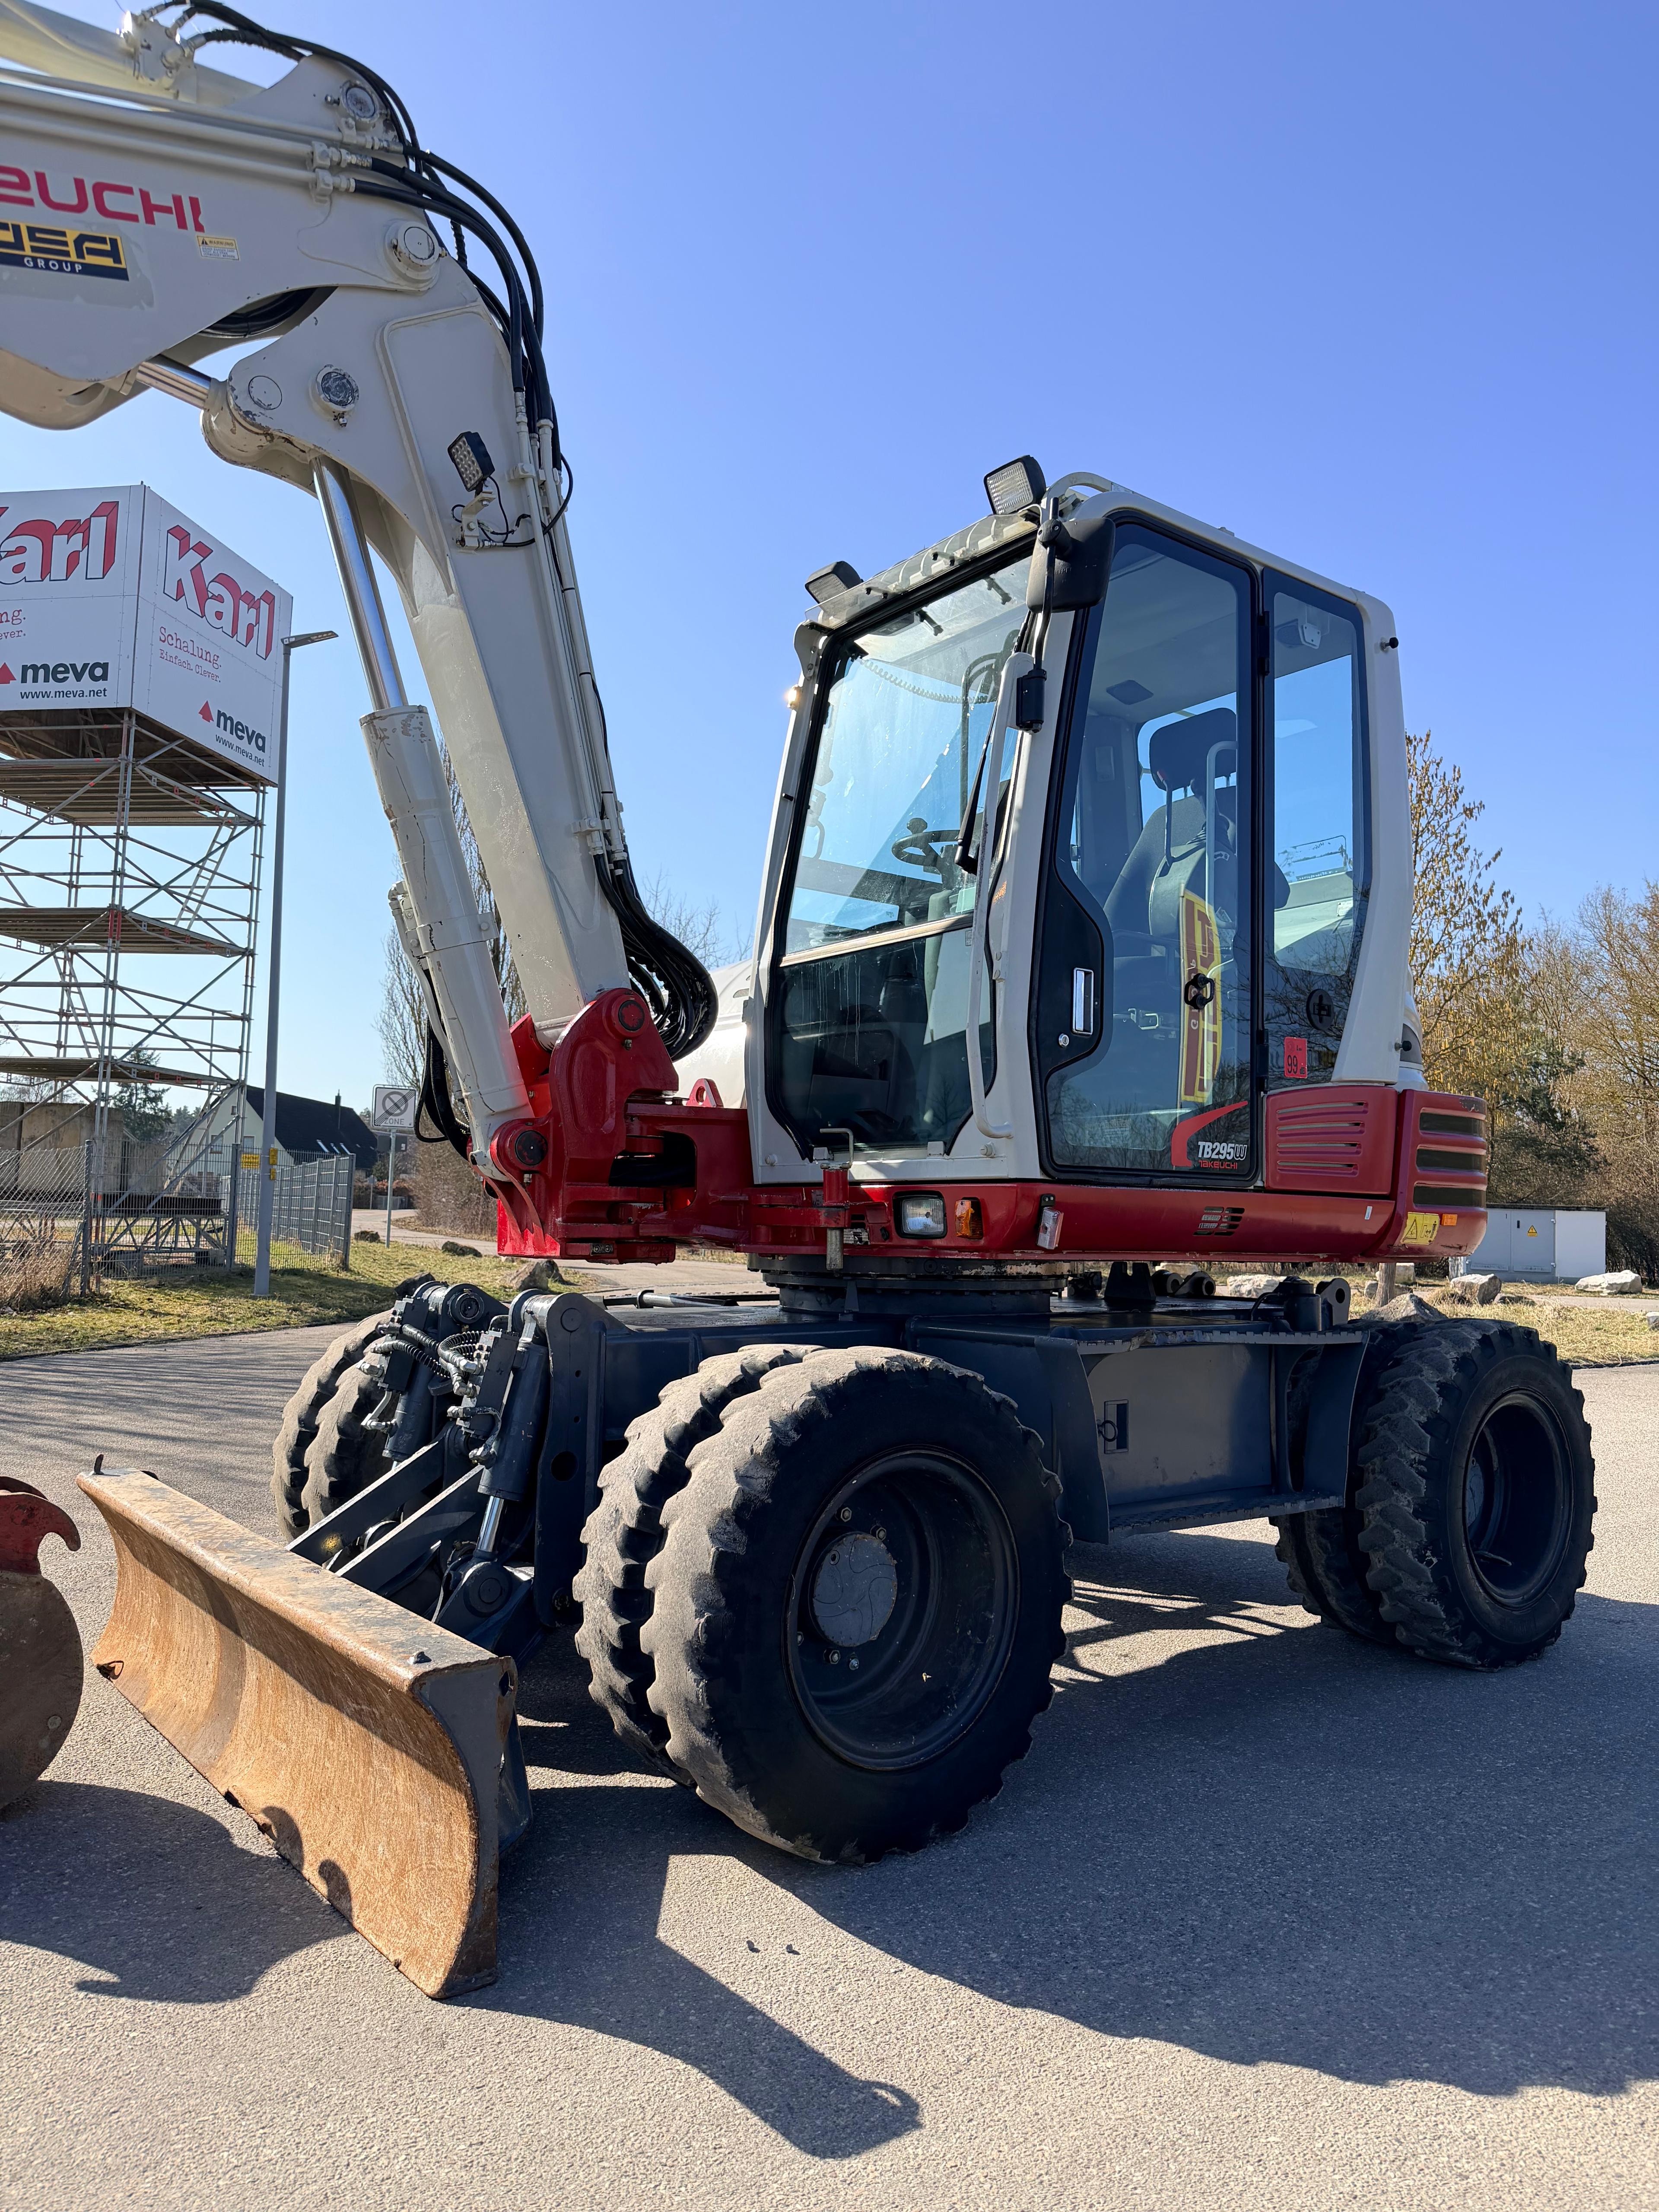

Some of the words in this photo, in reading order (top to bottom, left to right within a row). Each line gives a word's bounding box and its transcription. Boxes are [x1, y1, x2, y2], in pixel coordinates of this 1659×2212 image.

[24, 257, 82, 273] GROUP
[0, 501, 119, 585] arl
[163, 524, 275, 661] Karl
[159, 626, 221, 669] Schalung.
[21, 662, 109, 683] meva
[159, 649, 193, 671] Einfach.
[195, 664, 221, 683] Clever.
[20, 688, 107, 699] www.meva.net
[216, 709, 266, 753] meva
[216, 734, 264, 767] www.meva.net
[1287, 1055, 1298, 1074] 99
[1198, 1141, 1247, 1160] TB295W
